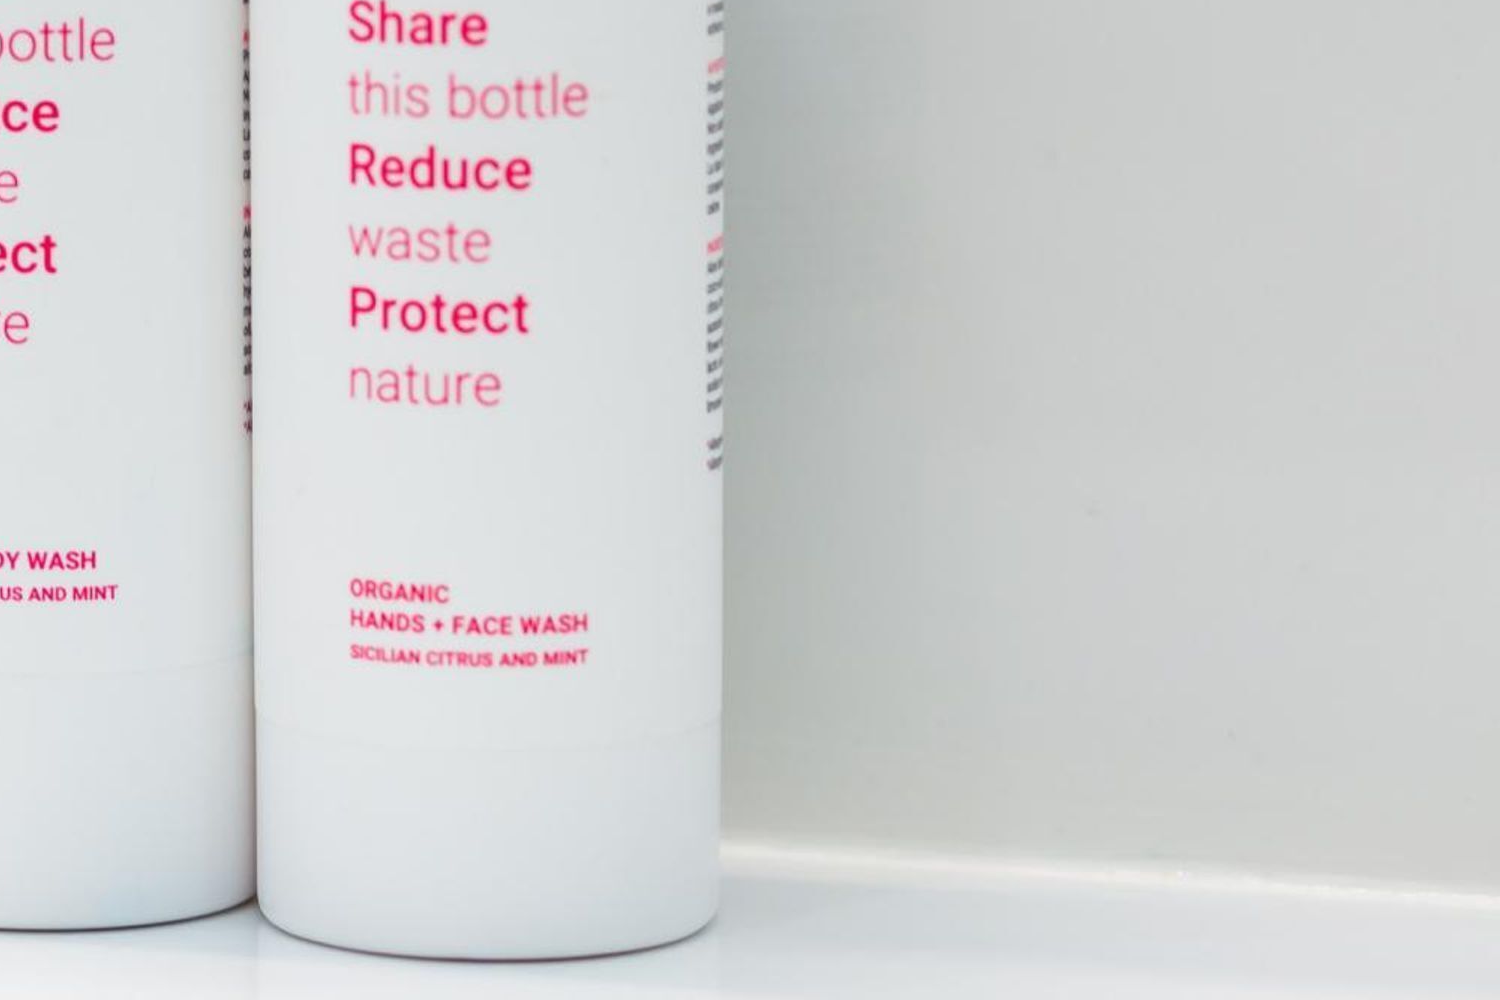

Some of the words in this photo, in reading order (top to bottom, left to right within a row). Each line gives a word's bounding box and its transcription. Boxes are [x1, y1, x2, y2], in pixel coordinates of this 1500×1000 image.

[348, 0, 489, 47] Share
[348, 69, 431, 120] this
[447, 72, 590, 121] bottle
[348, 142, 534, 193] Reduce
[348, 221, 493, 265] waste
[349, 285, 531, 337] Protect
[349, 363, 503, 408] nature
[27, 550, 97, 571] WASH
[28, 586, 67, 602] AND
[72, 584, 118, 601] MINT
[349, 577, 450, 604] ORGANIC
[349, 609, 425, 633] HANDS
[451, 615, 513, 636] FACE
[520, 613, 589, 635] WASH
[349, 643, 421, 664] SICILIAN
[425, 649, 493, 668] CITRUS
[499, 651, 537, 668] AND
[542, 648, 590, 666] MINT
